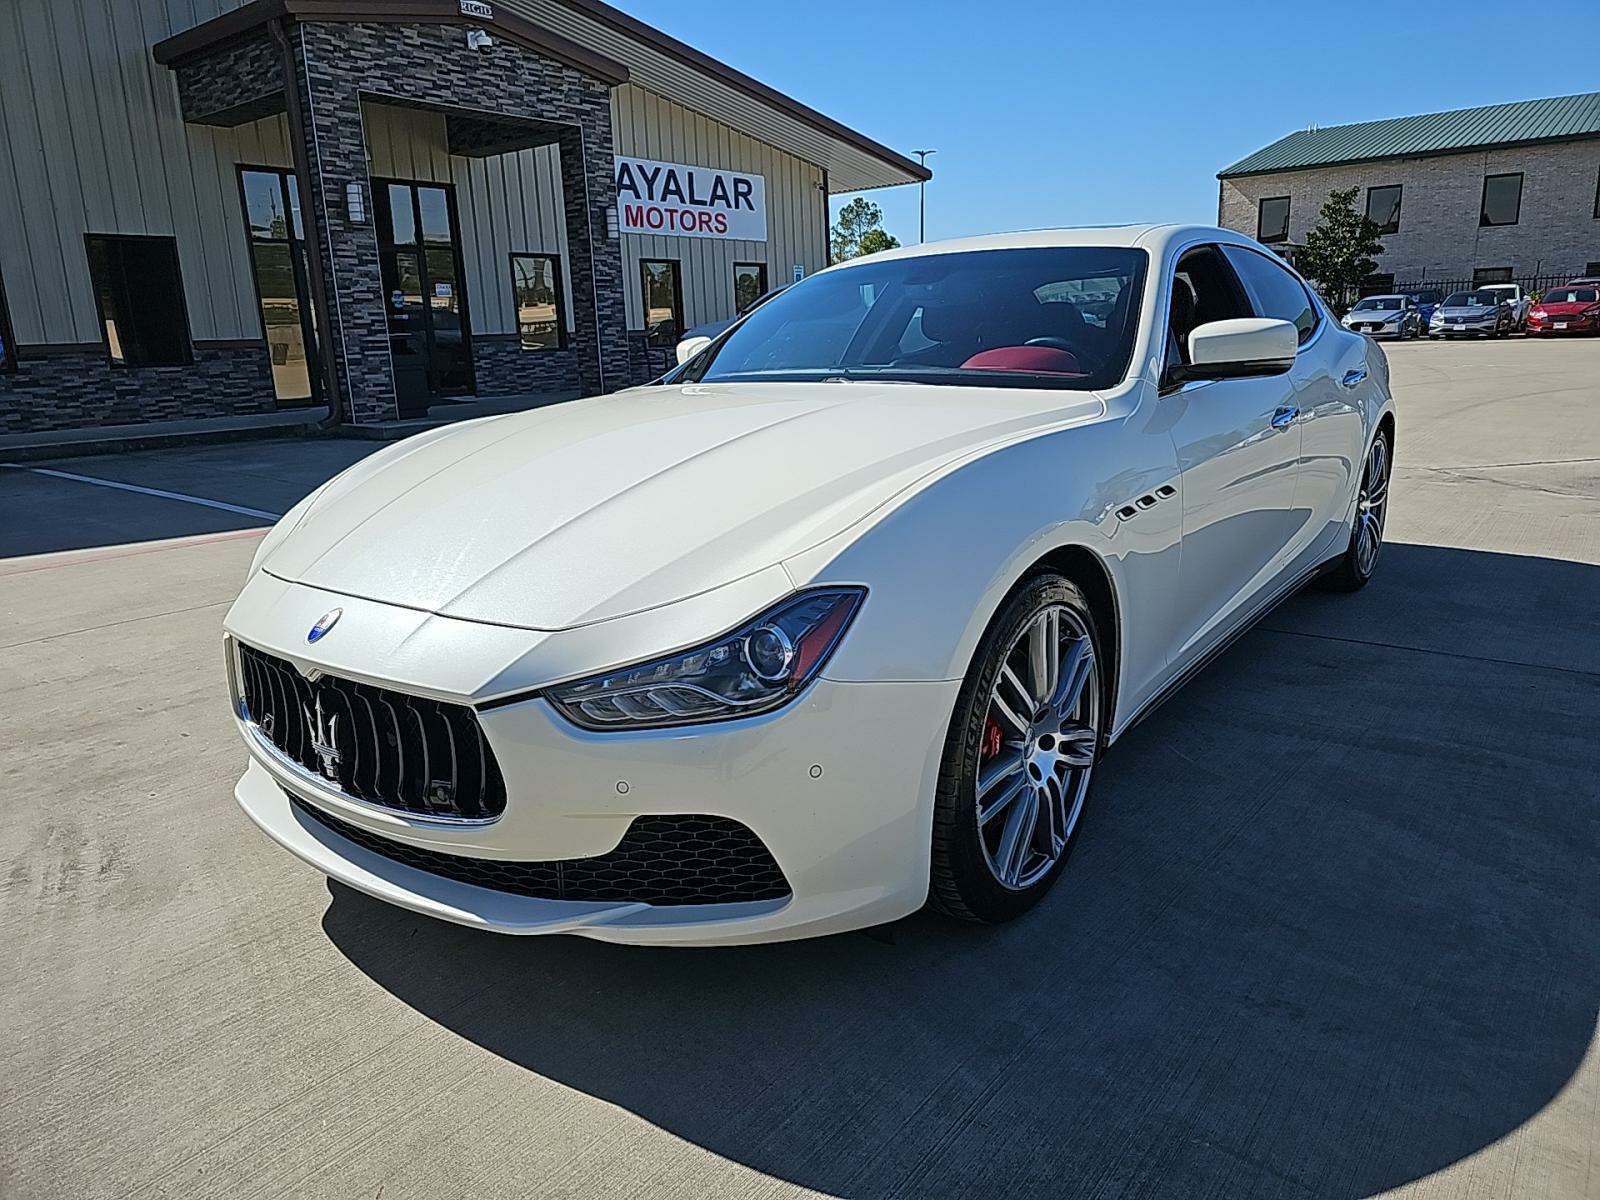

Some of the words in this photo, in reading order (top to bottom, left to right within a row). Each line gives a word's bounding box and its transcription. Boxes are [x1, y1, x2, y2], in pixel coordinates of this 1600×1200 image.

[460, 2, 492, 15] RIGID
[617, 162, 755, 211] AYALAR
[624, 204, 728, 234] MOTORS
